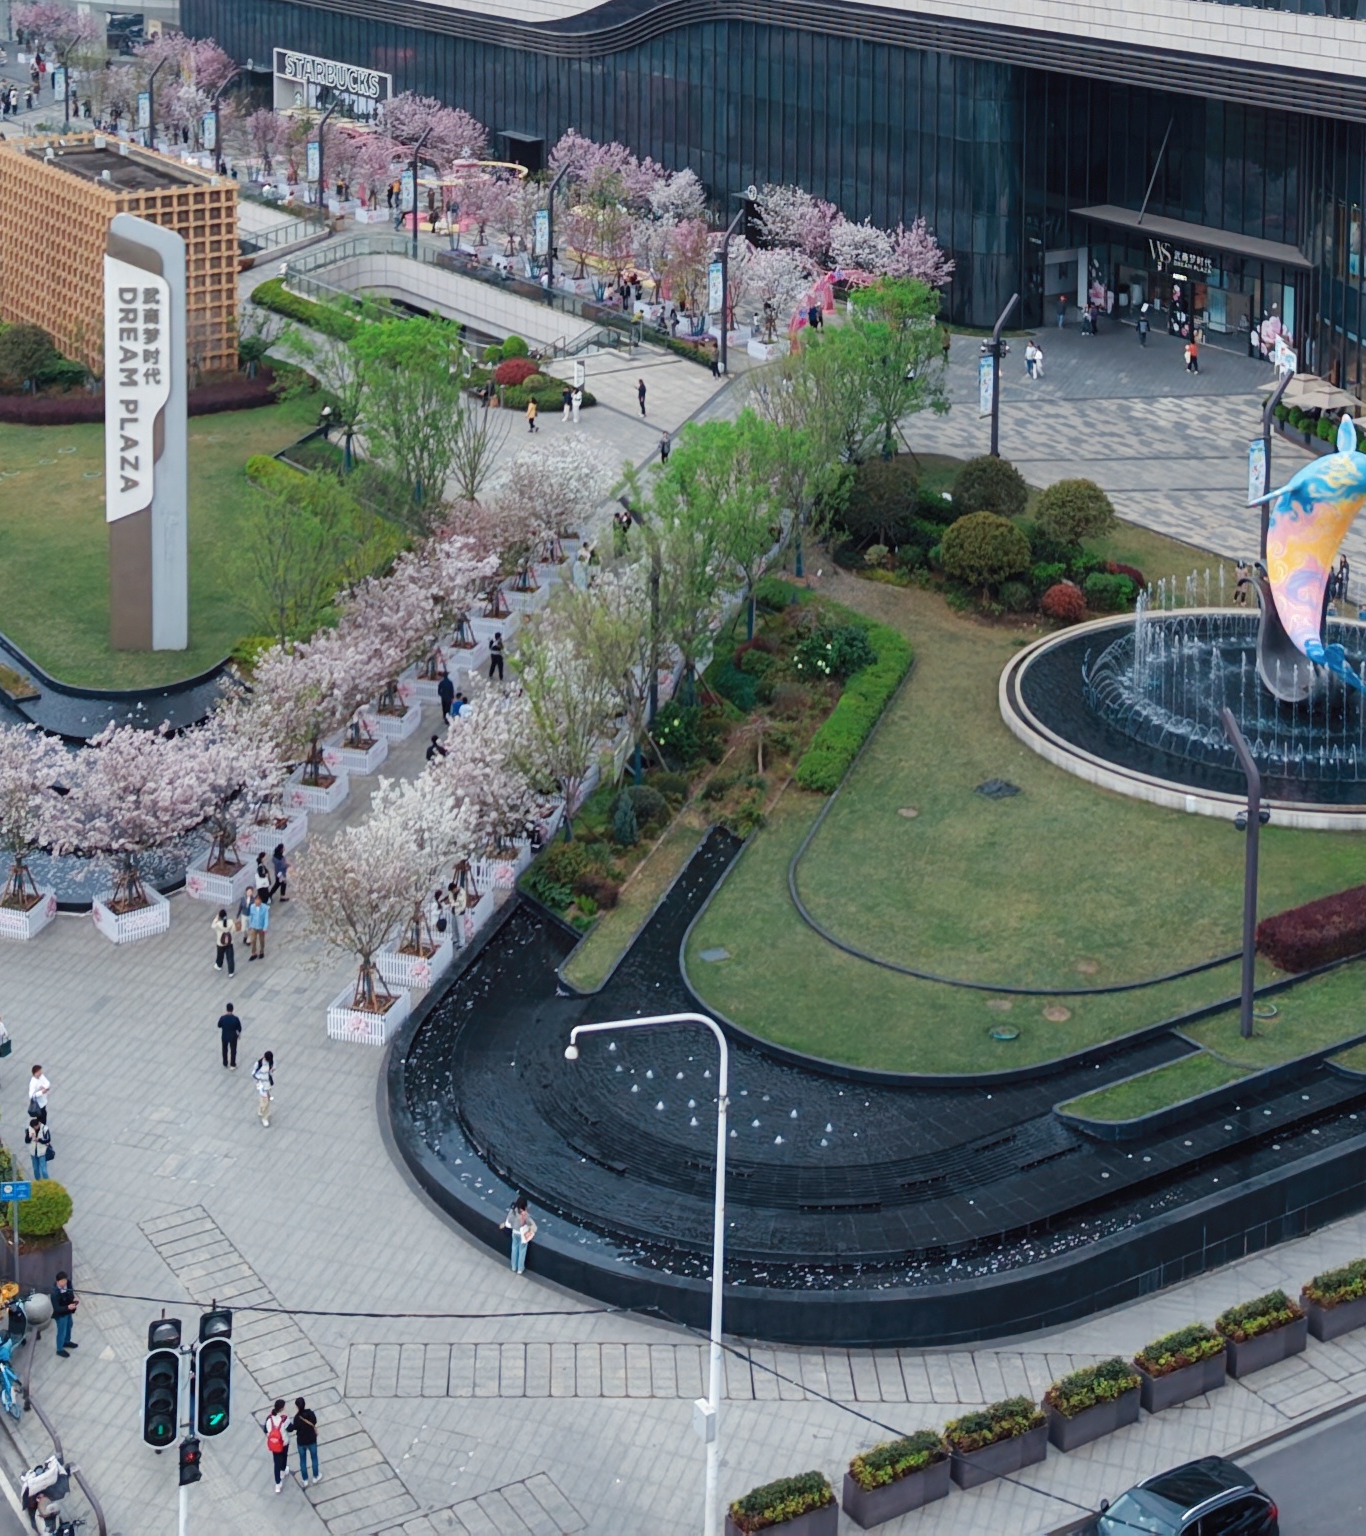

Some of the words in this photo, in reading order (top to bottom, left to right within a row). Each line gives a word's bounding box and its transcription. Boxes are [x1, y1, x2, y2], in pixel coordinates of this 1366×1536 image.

[284, 52, 380, 99] STARBUCKS
[118, 286, 138, 387] DREAM
[142, 286, 161, 385] 武商梦时代
[119, 399, 140, 493] PLAZA
